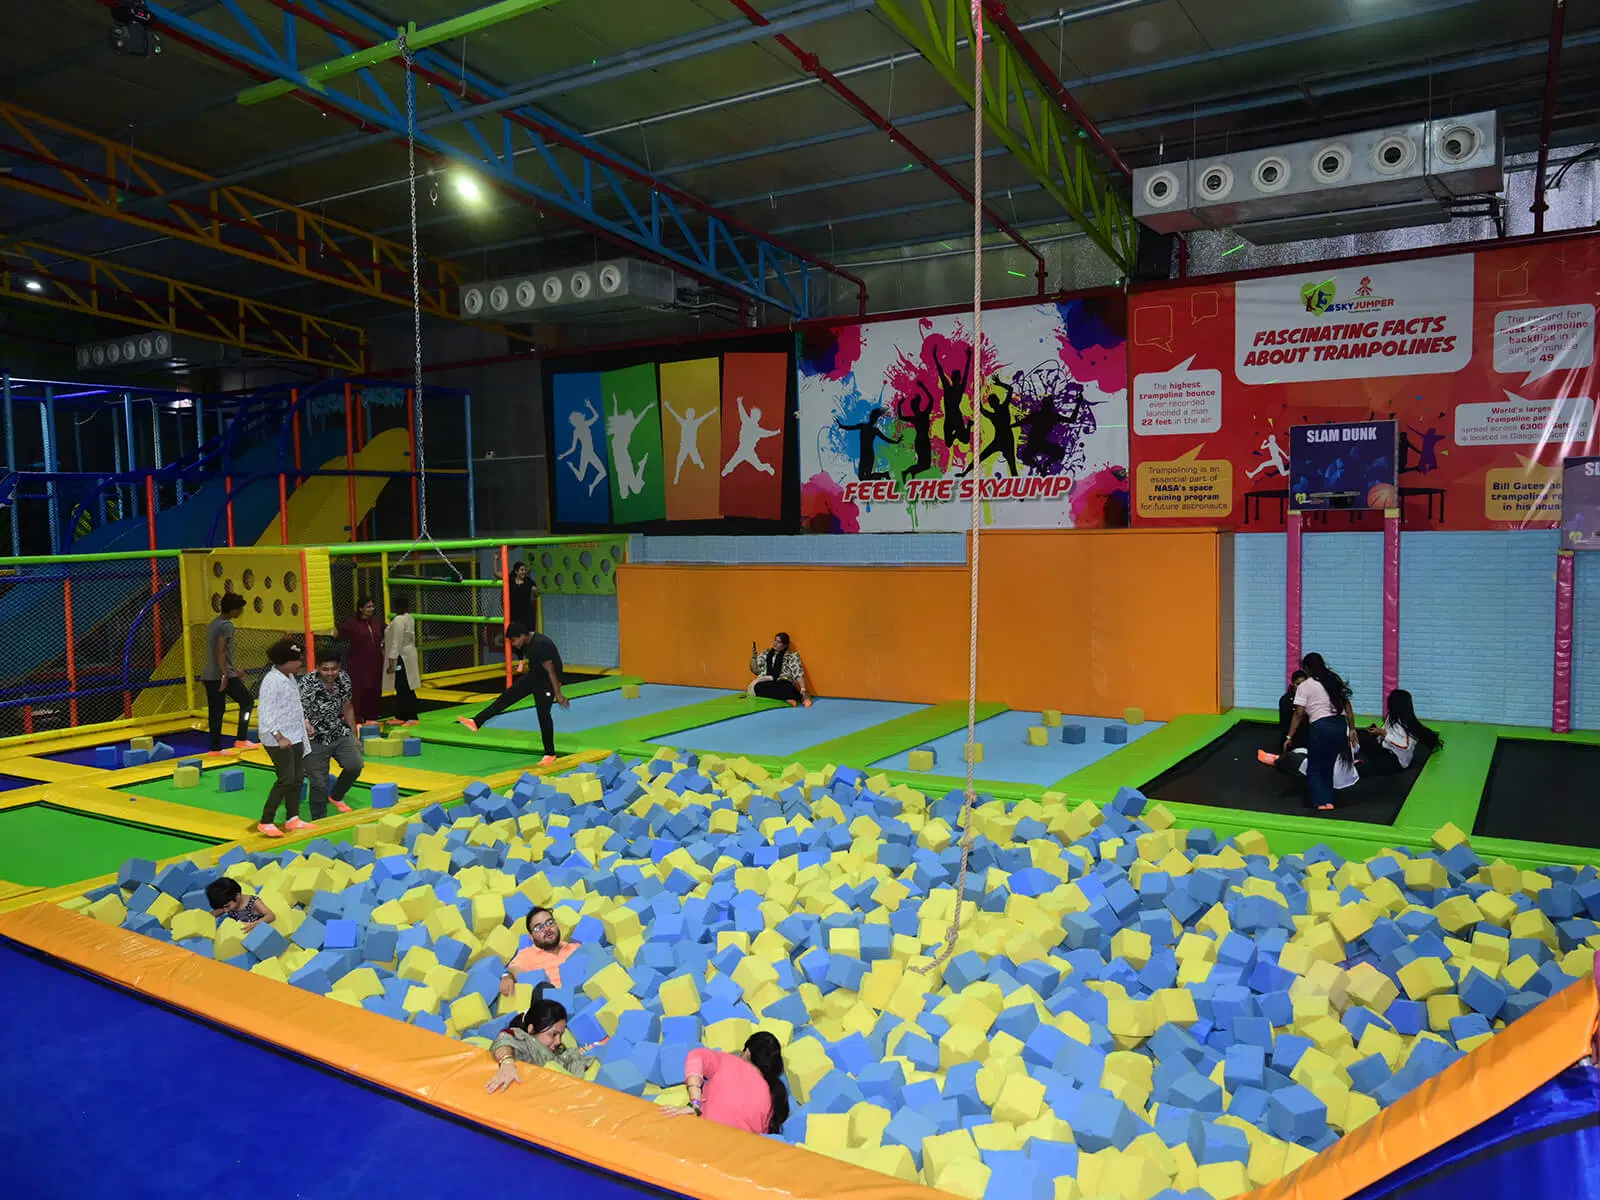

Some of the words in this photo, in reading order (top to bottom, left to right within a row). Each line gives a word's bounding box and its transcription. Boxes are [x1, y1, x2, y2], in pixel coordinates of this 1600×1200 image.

[1507, 315, 1525, 323] The
[1567, 310, 1582, 319] for
[1253, 321, 1379, 347] FASCINATING
[1381, 315, 1447, 337] FACTS
[1530, 321, 1589, 332] trampoline
[1509, 333, 1556, 344] backflips
[1243, 347, 1312, 366] ABOUT
[1313, 335, 1457, 361] TRAMPOLINES
[1509, 345, 1538, 355] single
[1542, 343, 1578, 352] minue
[1540, 353, 1554, 362] 49
[1169, 381, 1201, 390] highest
[1140, 392, 1183, 400] trampoline
[1169, 399, 1205, 407] recorded
[1146, 408, 1181, 417] launched
[1526, 405, 1554, 413] larges
[1533, 414, 1552, 422] par
[1306, 428, 1340, 443] SLAM
[1342, 426, 1377, 441] DUNK
[1510, 431, 1540, 441] Glasgo
[1149, 466, 1198, 474] Trampolining
[1585, 462, 1600, 476] SL
[1151, 475, 1187, 483] essential
[1210, 474, 1218, 482] of
[845, 481, 899, 500] FEEL
[905, 479, 954, 499] THE
[959, 475, 1072, 498] SKYJUMP
[1154, 484, 1186, 492] NASA's
[1493, 482, 1510, 490] Bill
[1513, 481, 1545, 490] Gates
[1184, 494, 1219, 502] program
[1491, 492, 1548, 502] trampoline
[1155, 502, 1179, 510] future
[1182, 502, 1228, 510] astronauts
[1535, 503, 1561, 511] hous
